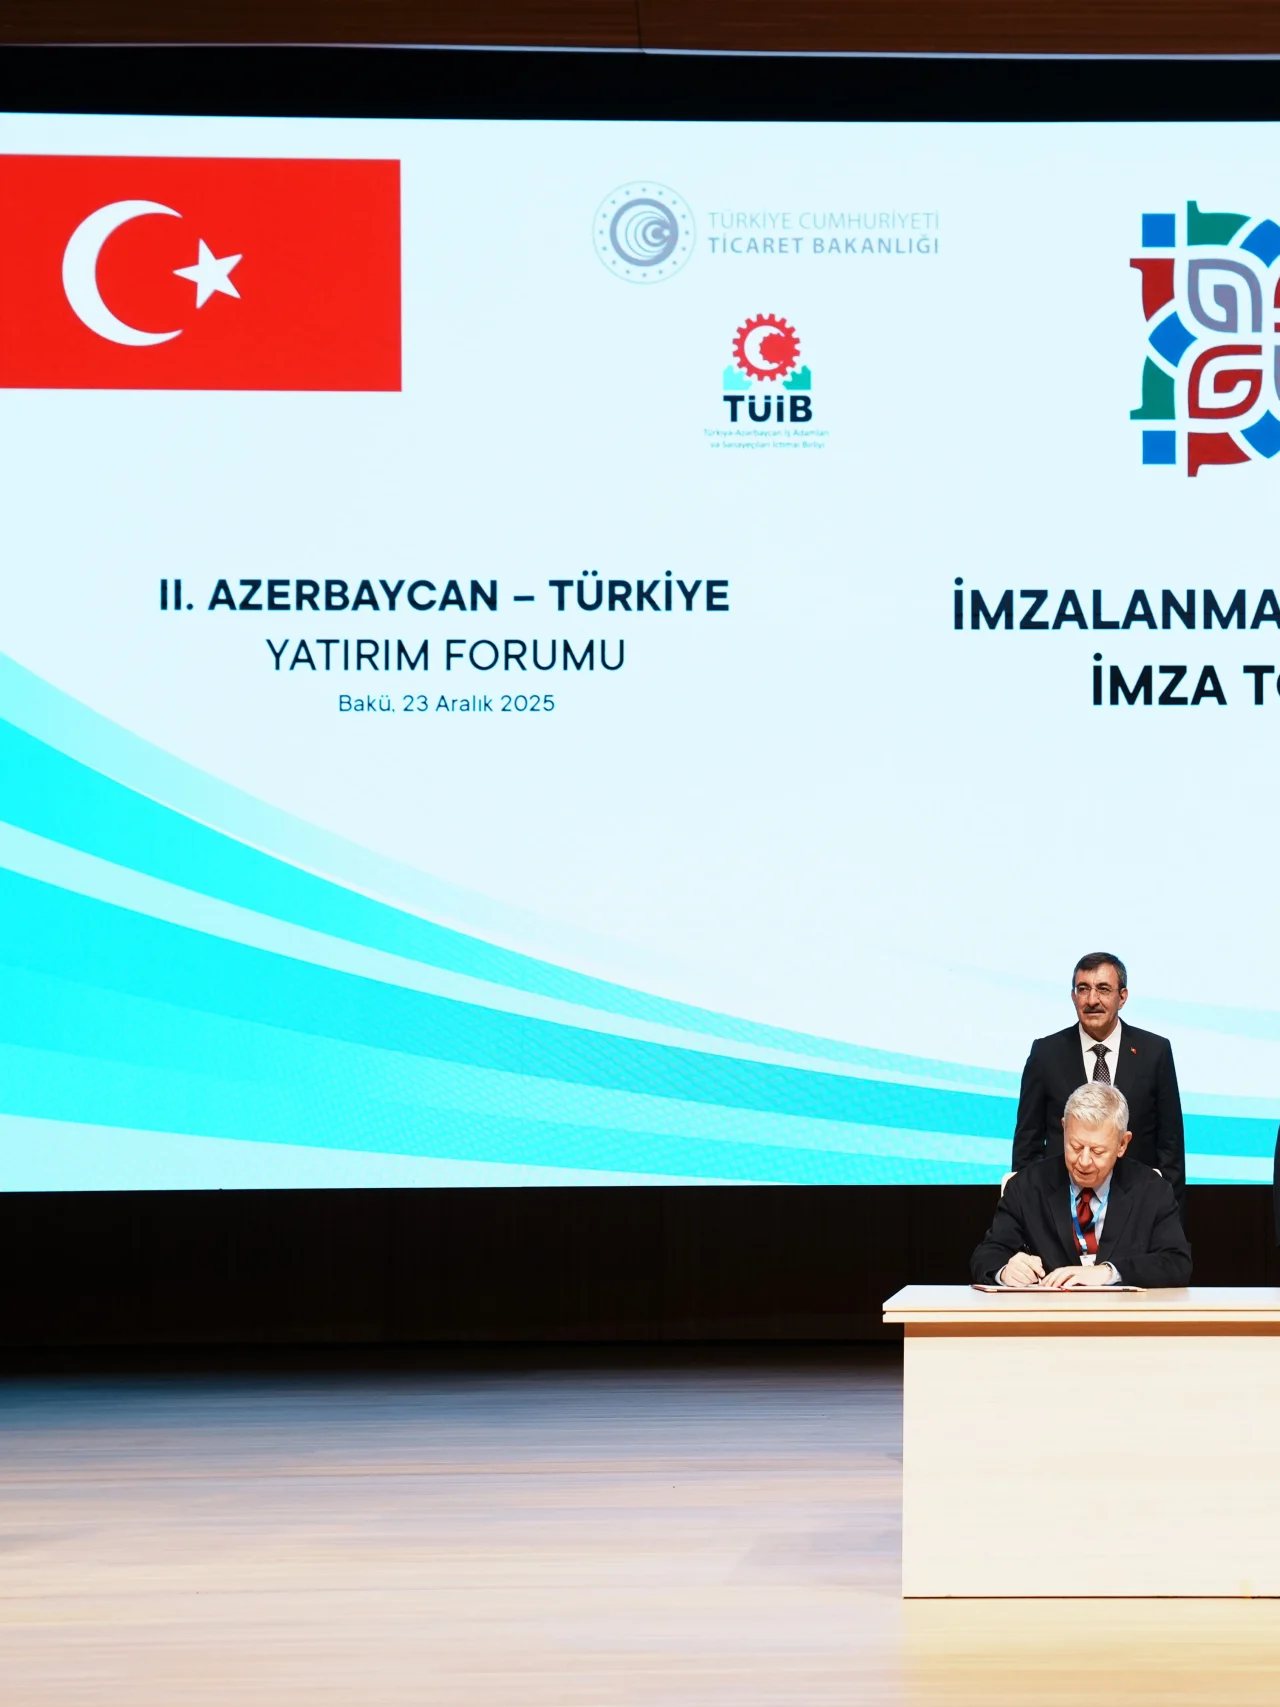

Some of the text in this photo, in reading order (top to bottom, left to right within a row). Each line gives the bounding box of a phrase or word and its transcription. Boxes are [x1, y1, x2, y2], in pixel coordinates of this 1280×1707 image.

[707, 208, 939, 230] TÜRKİYE CUMHURİYETİ
[707, 234, 939, 255] TİCARET BAKANLIĞI
[159, 578, 194, 612] II.
[207, 578, 498, 612] AZERBAYCAN
[548, 569, 730, 612] TÜRKİYE
[265, 638, 625, 672] YATIRIM FORUMU
[1092, 652, 1228, 707] İMZA
[338, 694, 555, 713] Bakü, 23 Aralık 2025
